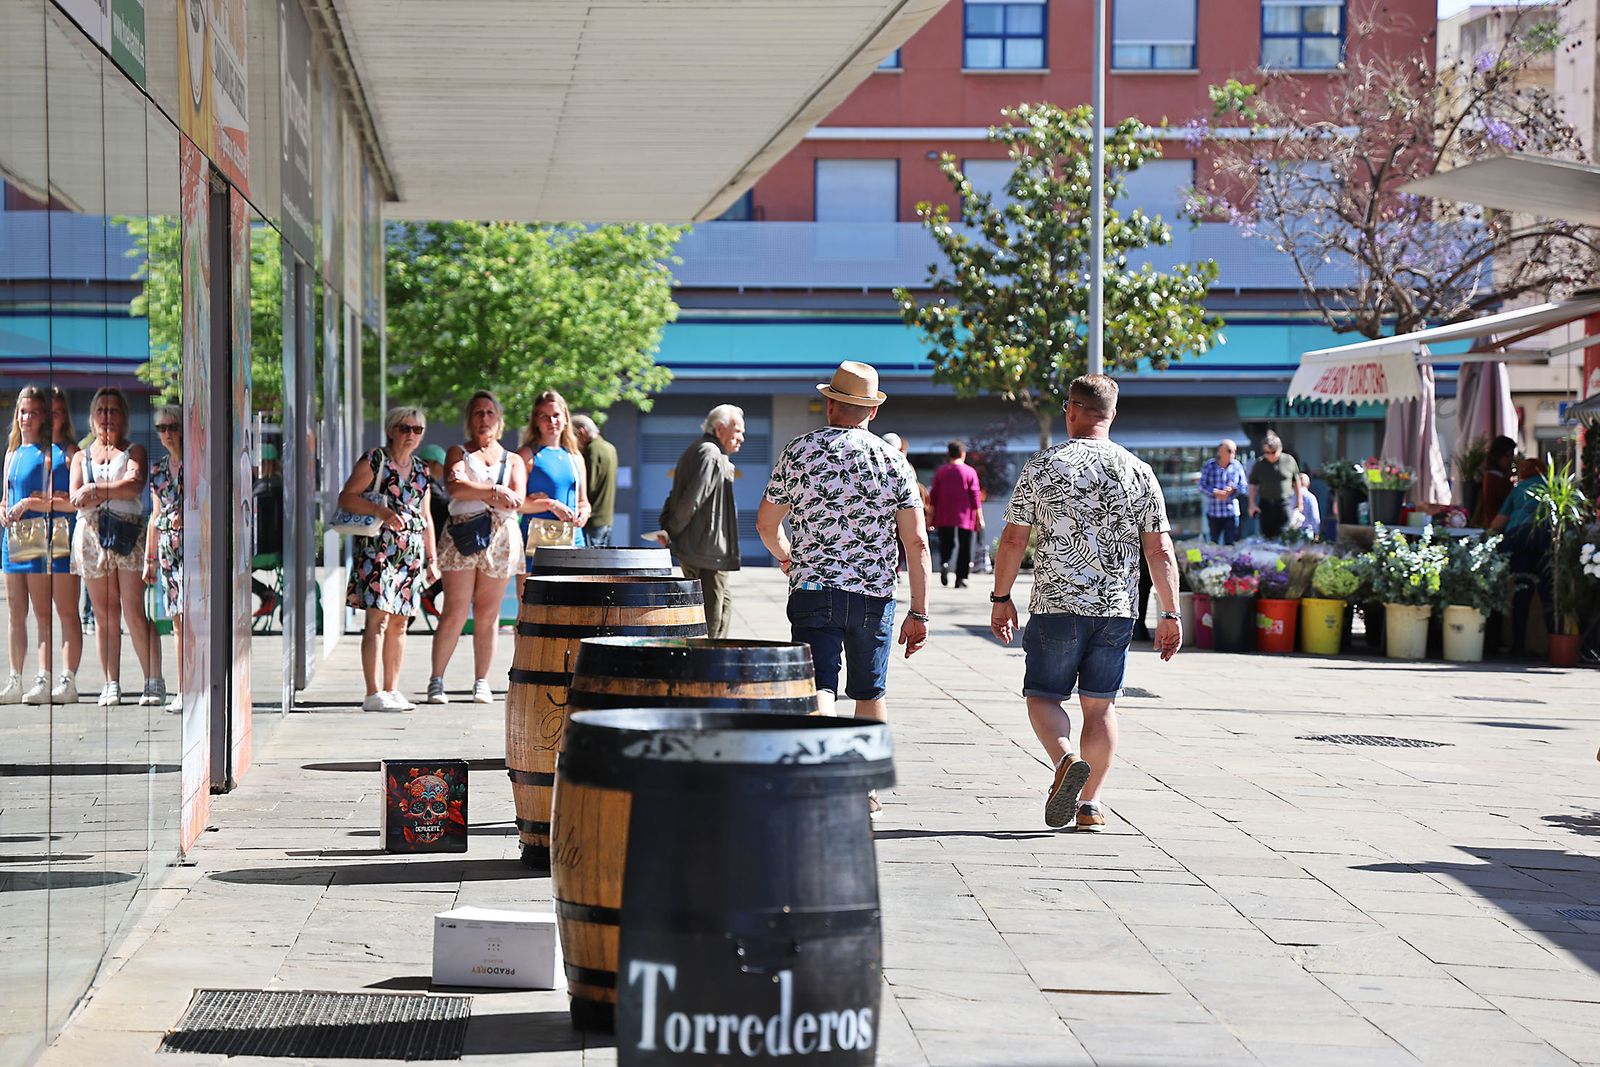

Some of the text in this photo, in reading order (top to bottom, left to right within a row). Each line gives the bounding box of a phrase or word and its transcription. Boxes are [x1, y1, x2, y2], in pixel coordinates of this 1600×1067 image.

[1265, 397, 1357, 416] Aromas
[471, 966, 515, 975] PRADOREY
[628, 960, 874, 1057] Torrederos
